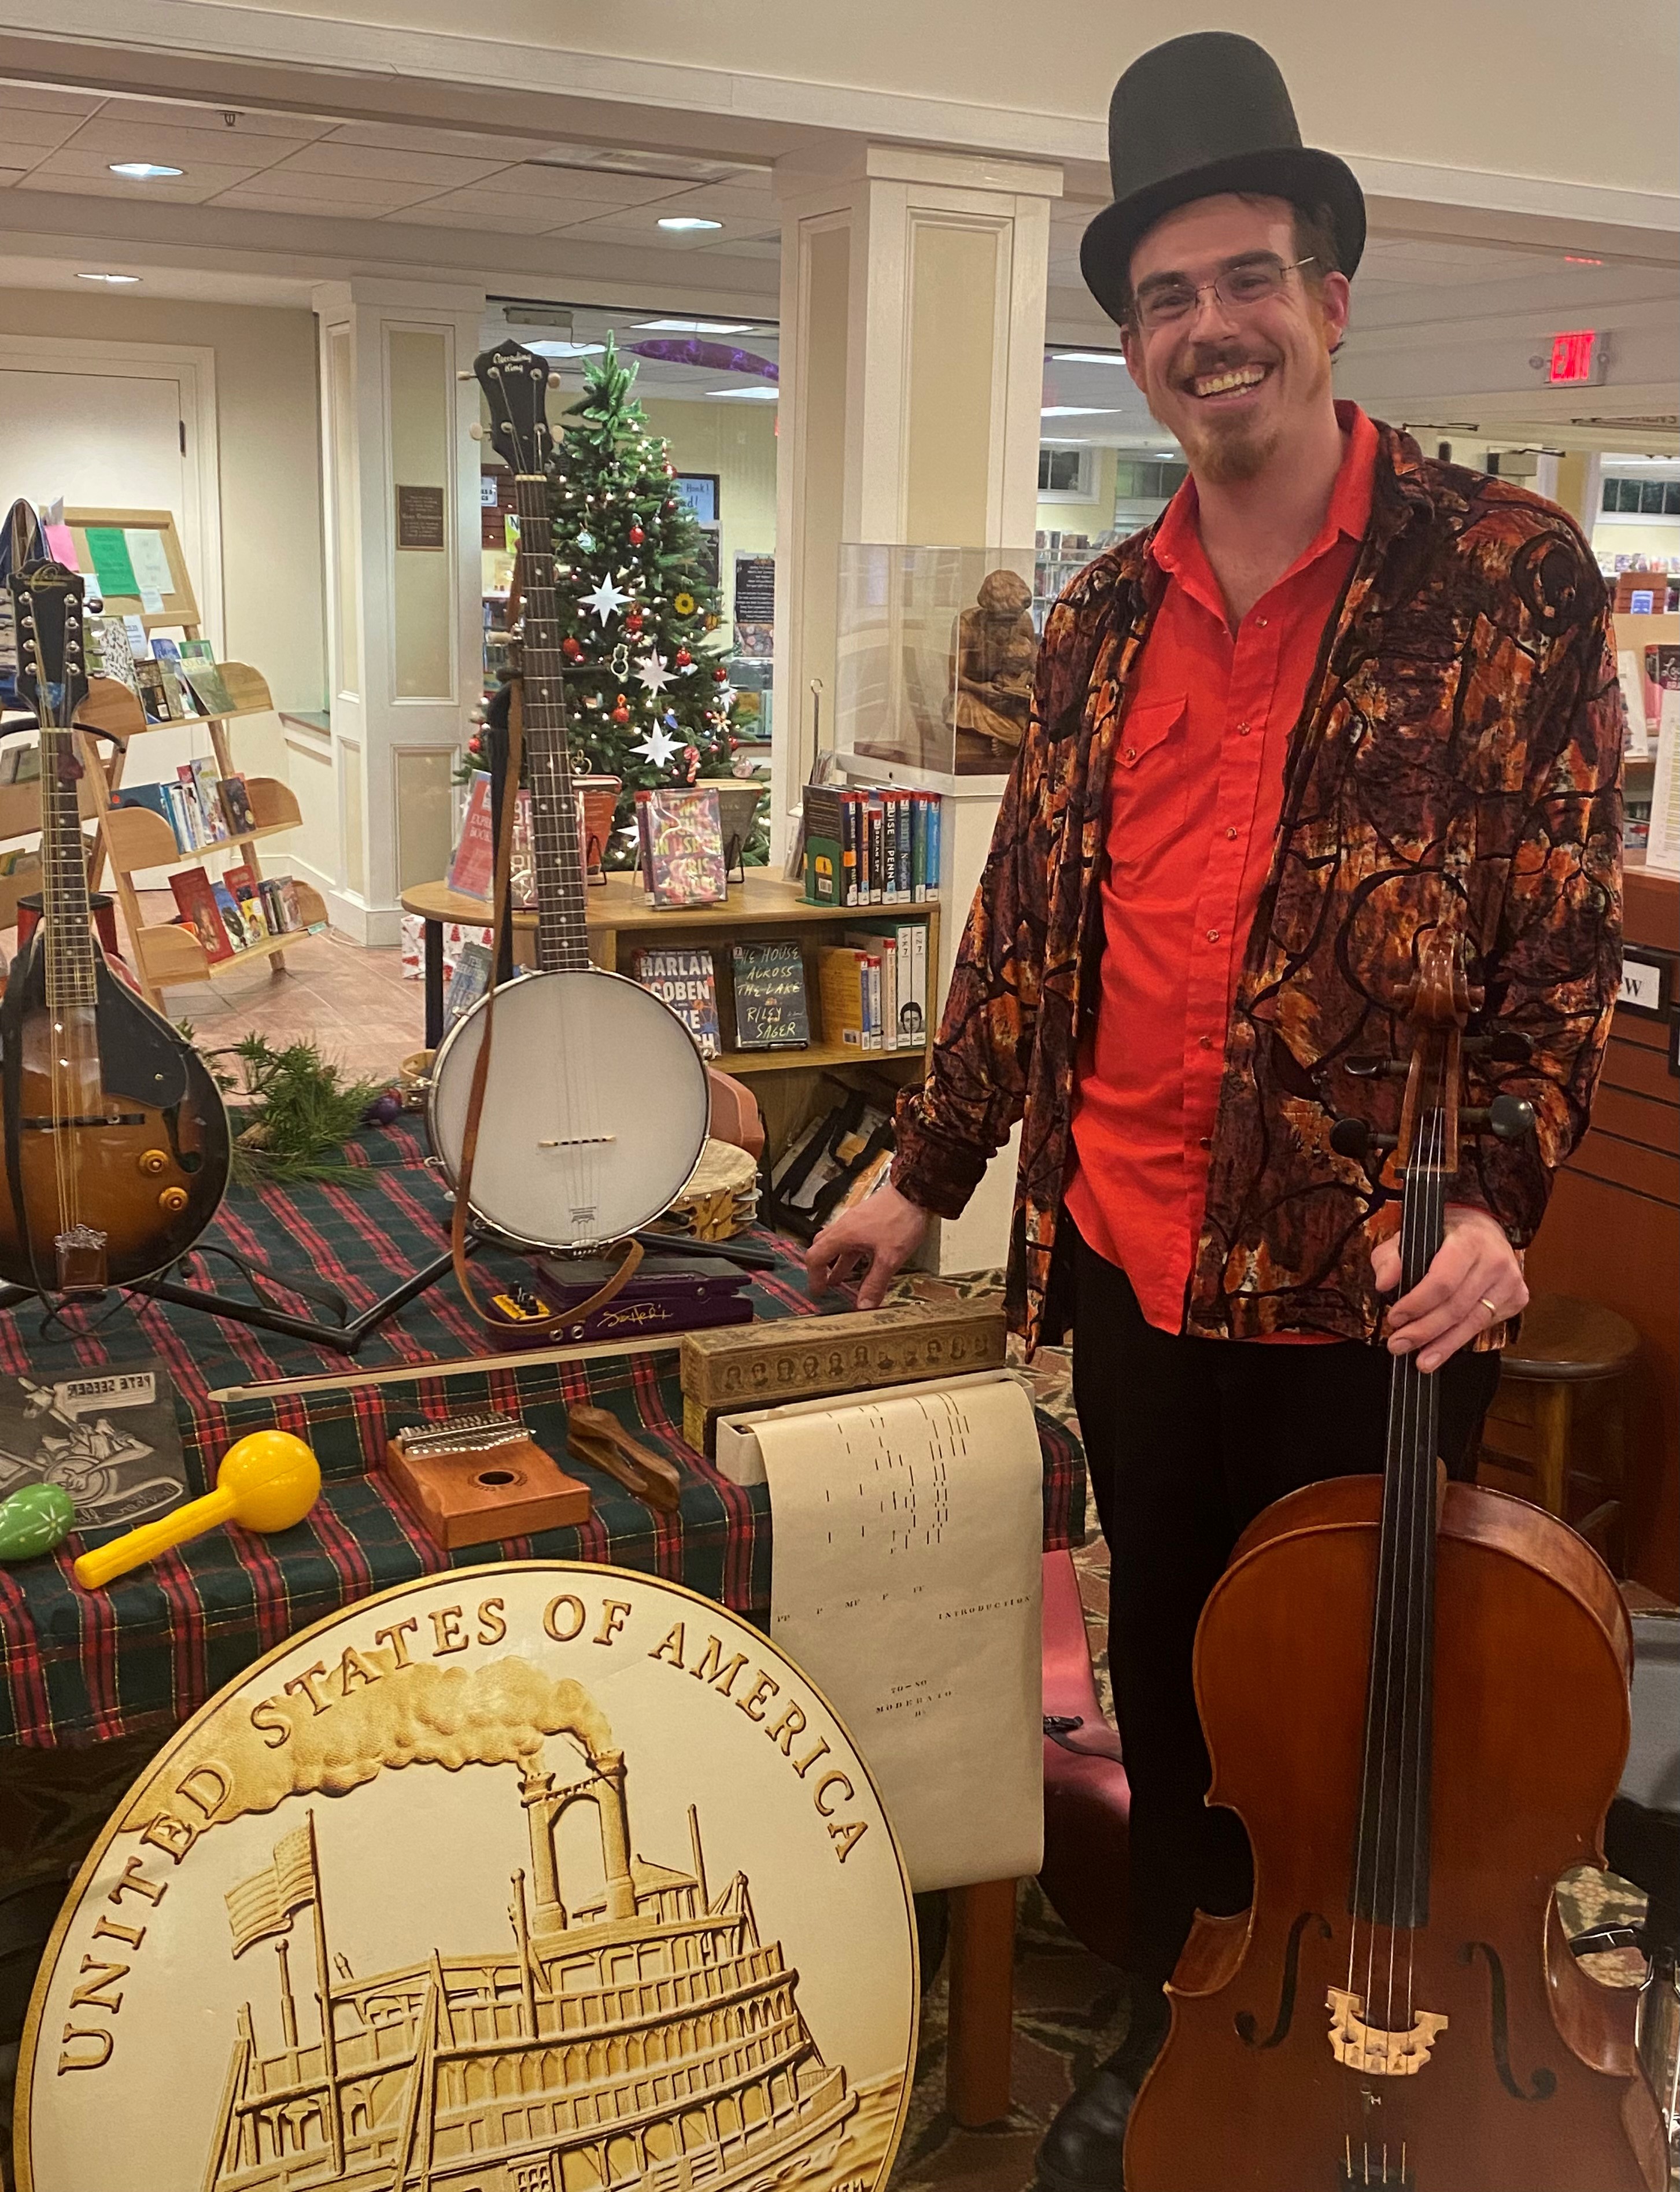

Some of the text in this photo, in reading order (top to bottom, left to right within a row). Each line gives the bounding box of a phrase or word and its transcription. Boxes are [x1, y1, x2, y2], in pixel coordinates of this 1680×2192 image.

[1551, 335, 1594, 381] EXIT
[640, 955, 714, 976] HARLAN
[741, 947, 800, 964] HE HOUSE
[747, 965, 795, 980] ACROSS
[651, 981, 710, 1002] COBEN
[737, 982, 802, 997] THE LAKE
[747, 1007, 781, 1023] RILEY
[756, 1022, 796, 1039] SAGER
[939, 1595, 1032, 1619] INTRODUCTION
[876, 1691, 951, 1714] MODERATO
[58, 1595, 869, 2076] UNITED STATES OF AMERICA
